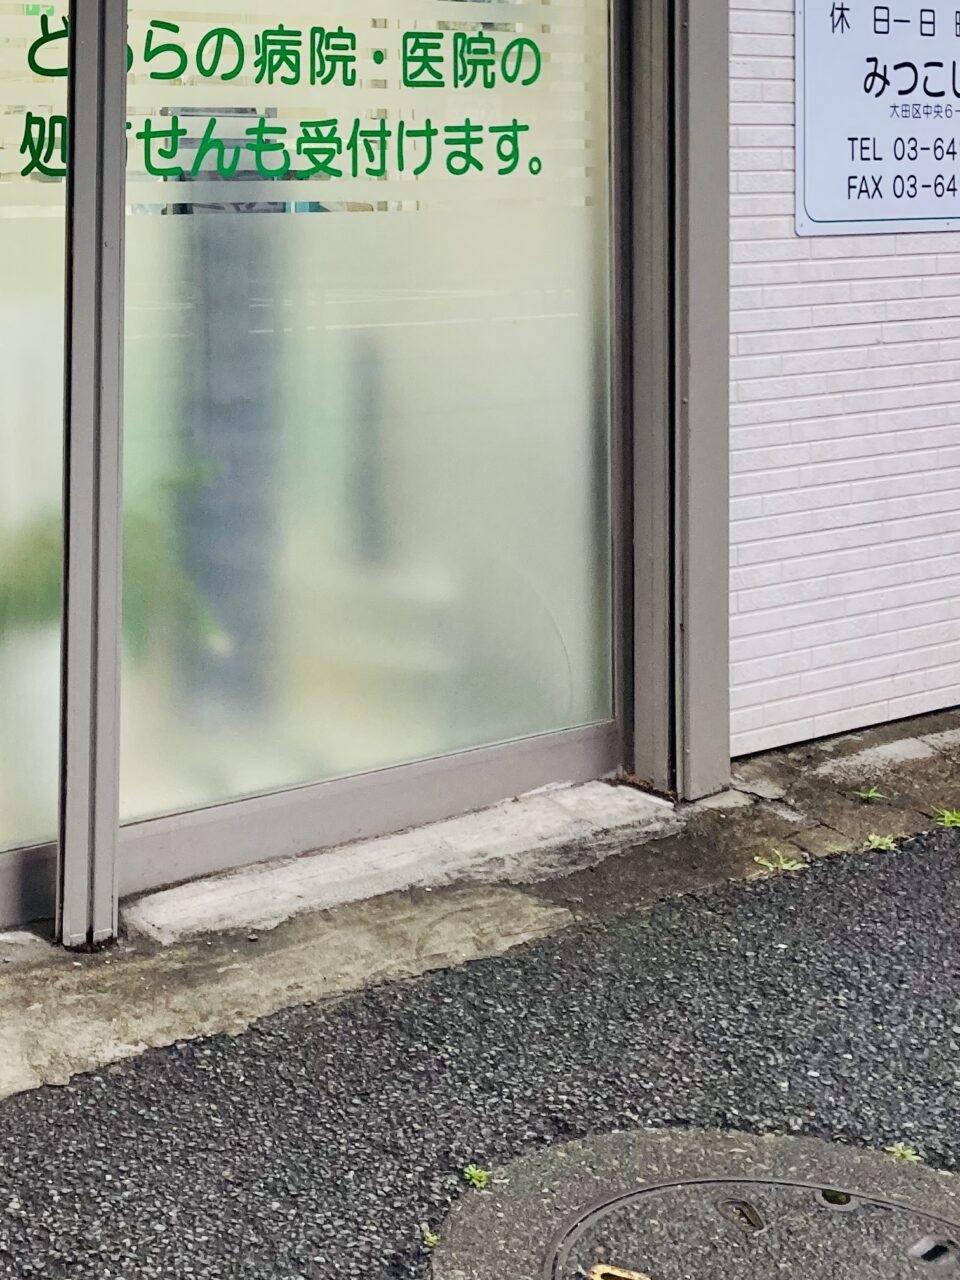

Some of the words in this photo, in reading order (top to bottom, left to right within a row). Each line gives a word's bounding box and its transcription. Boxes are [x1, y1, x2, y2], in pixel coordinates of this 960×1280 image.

[28, 14, 541, 89] どらの病院・医院の
[19, 112, 542, 178] 処せんも受付けます。
[848, 137, 883, 162] TEL
[893, 137, 958, 161] 03-64
[848, 175, 883, 200] FAX
[893, 174, 958, 198] 03-64
